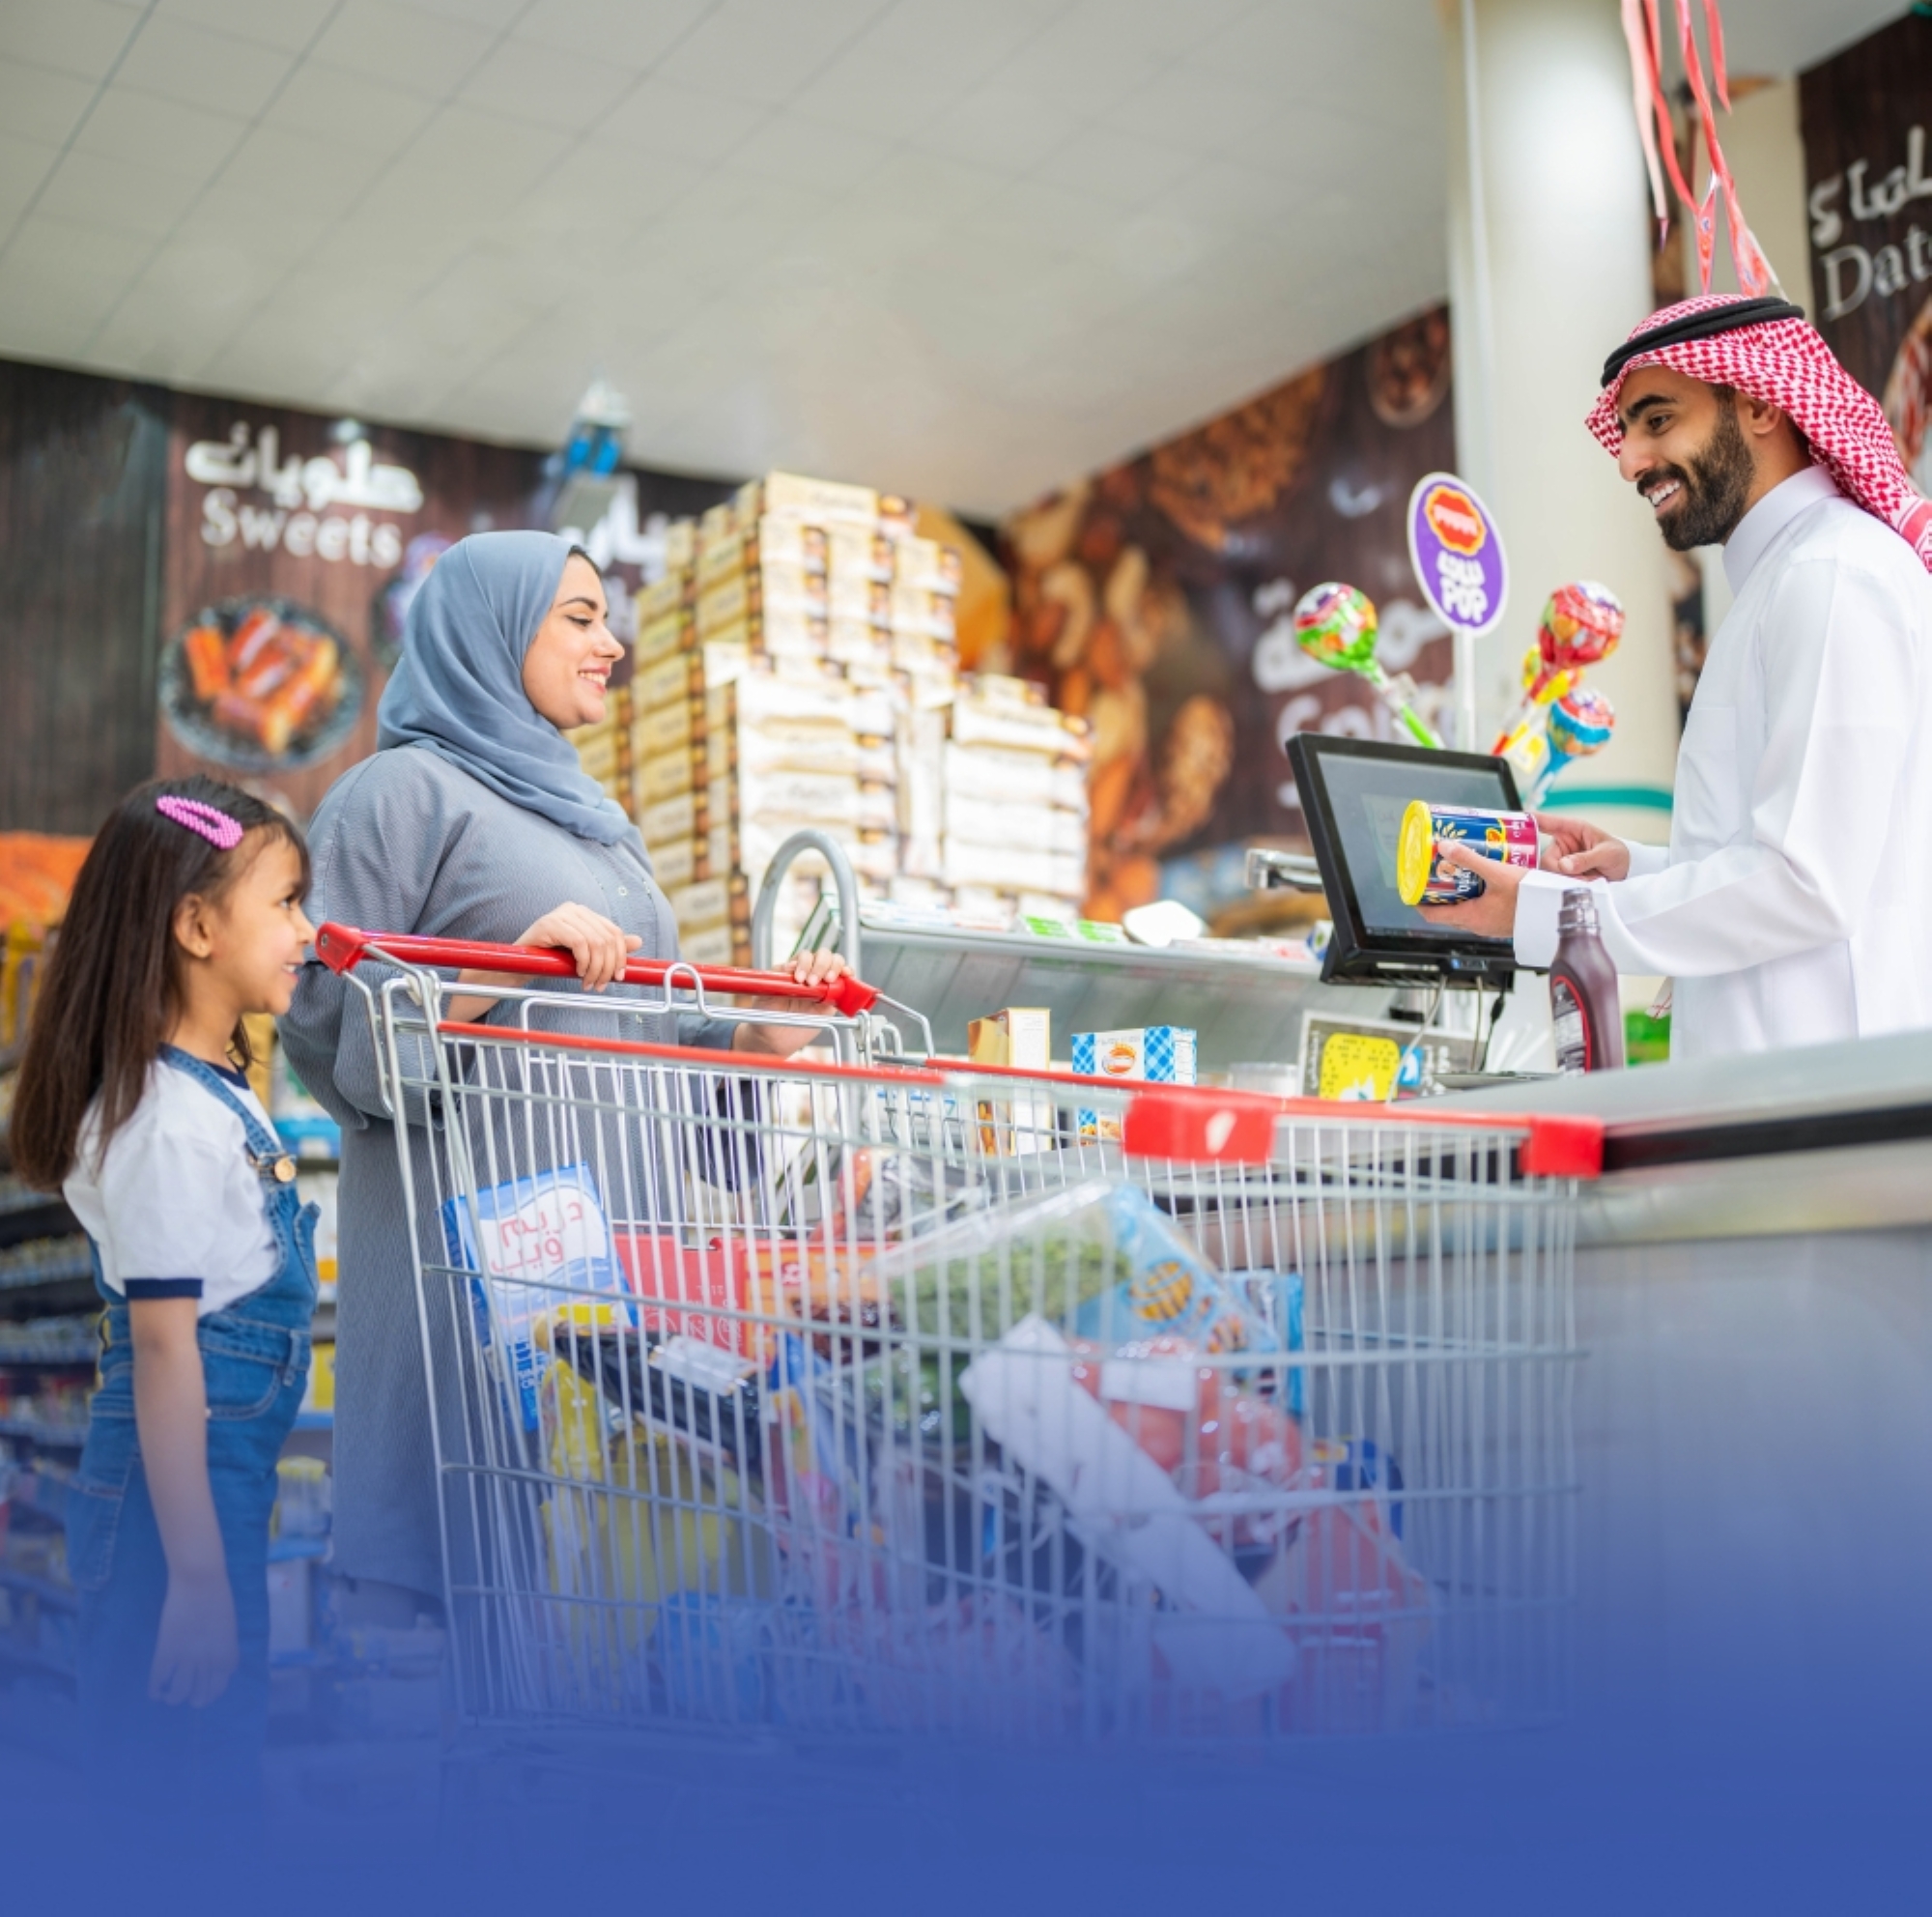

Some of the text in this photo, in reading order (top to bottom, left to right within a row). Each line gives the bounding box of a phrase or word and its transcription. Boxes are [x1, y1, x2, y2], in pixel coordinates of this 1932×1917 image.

[1820, 224, 1932, 322] Dat
[185, 421, 423, 513] حلويات
[201, 487, 402, 569] Sweets
[1439, 575, 1489, 624] POP
